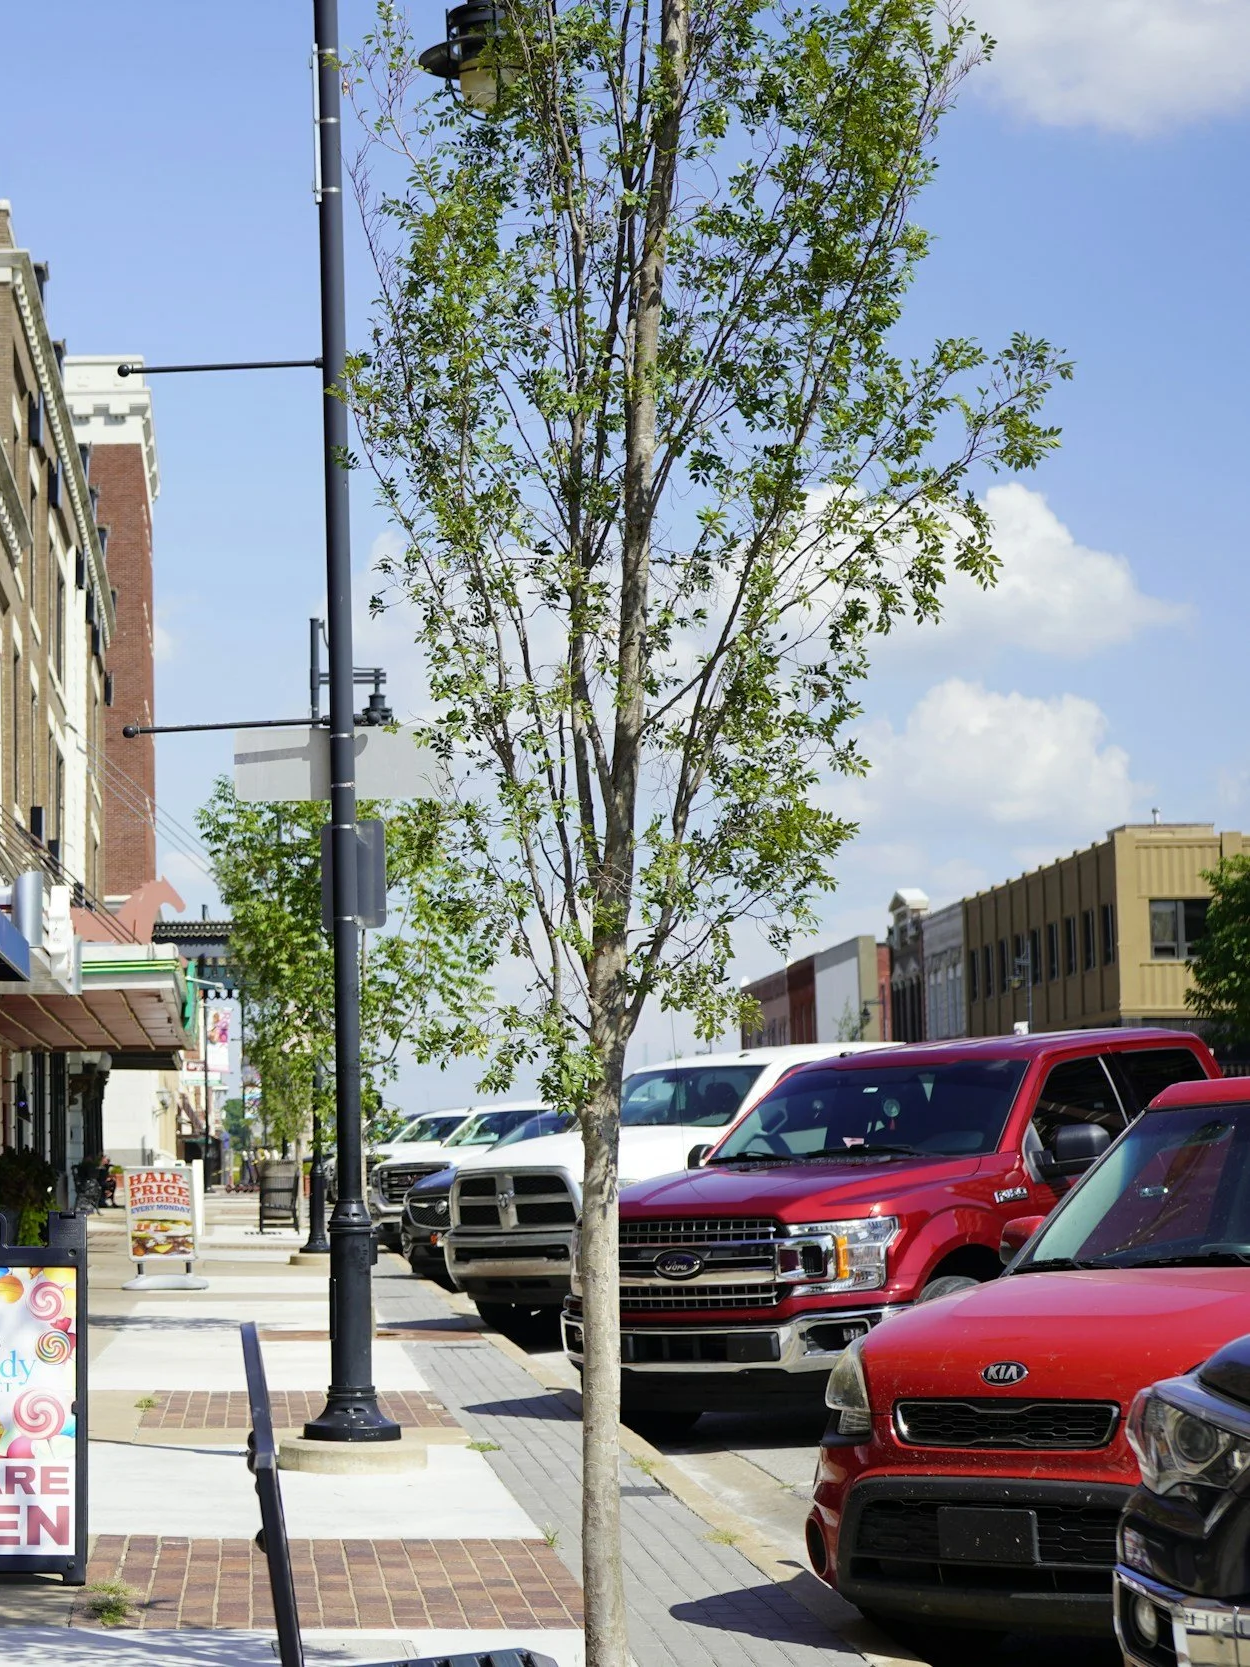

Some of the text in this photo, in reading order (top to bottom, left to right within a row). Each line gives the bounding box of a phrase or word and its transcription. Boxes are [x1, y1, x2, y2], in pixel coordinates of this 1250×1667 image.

[129, 1172, 189, 1186] HALF-
[130, 1184, 190, 1198] PRICE
[131, 1196, 191, 1206] BURGERS
[131, 1204, 191, 1214] EVERY MONDAY
[987, 1365, 1018, 1380] KIA
